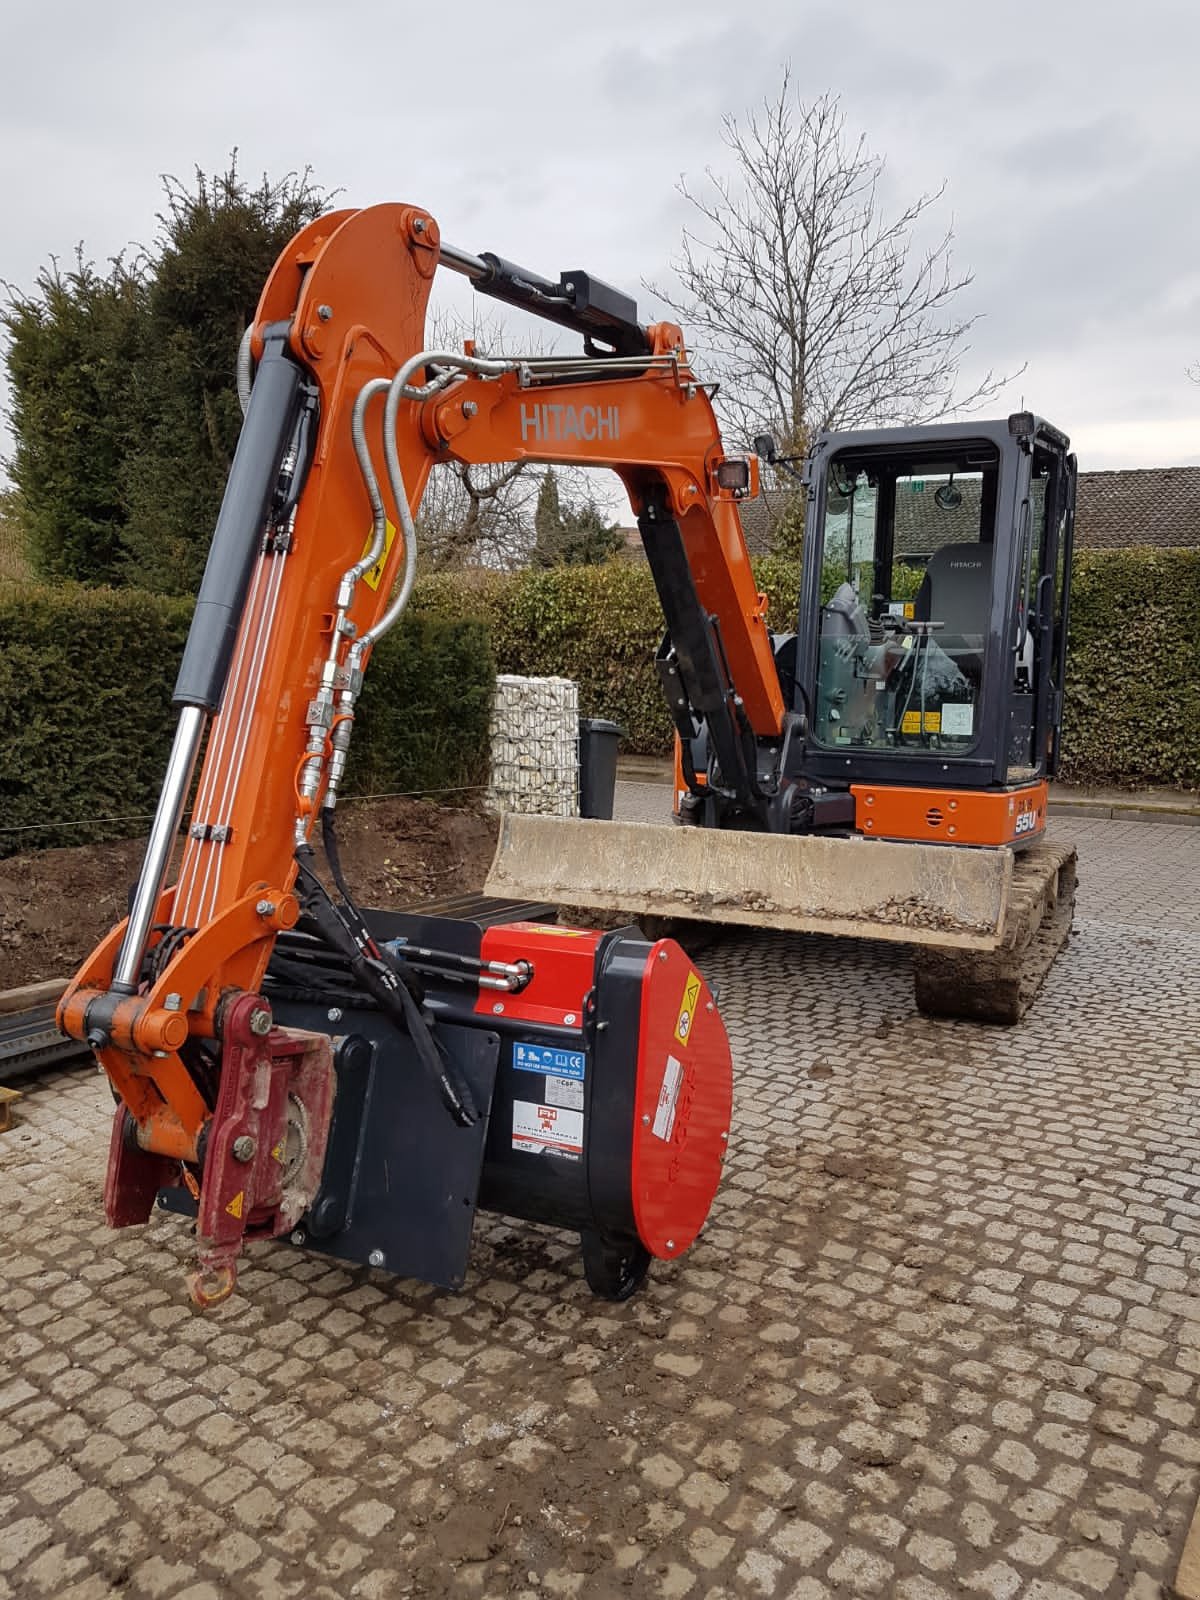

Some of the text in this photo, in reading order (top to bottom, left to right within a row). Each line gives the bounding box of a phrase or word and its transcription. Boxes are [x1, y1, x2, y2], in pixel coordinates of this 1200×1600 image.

[520, 403, 620, 441] HITACHI
[950, 561, 982, 569] HITACHI
[1015, 810, 1036, 832] 55U
